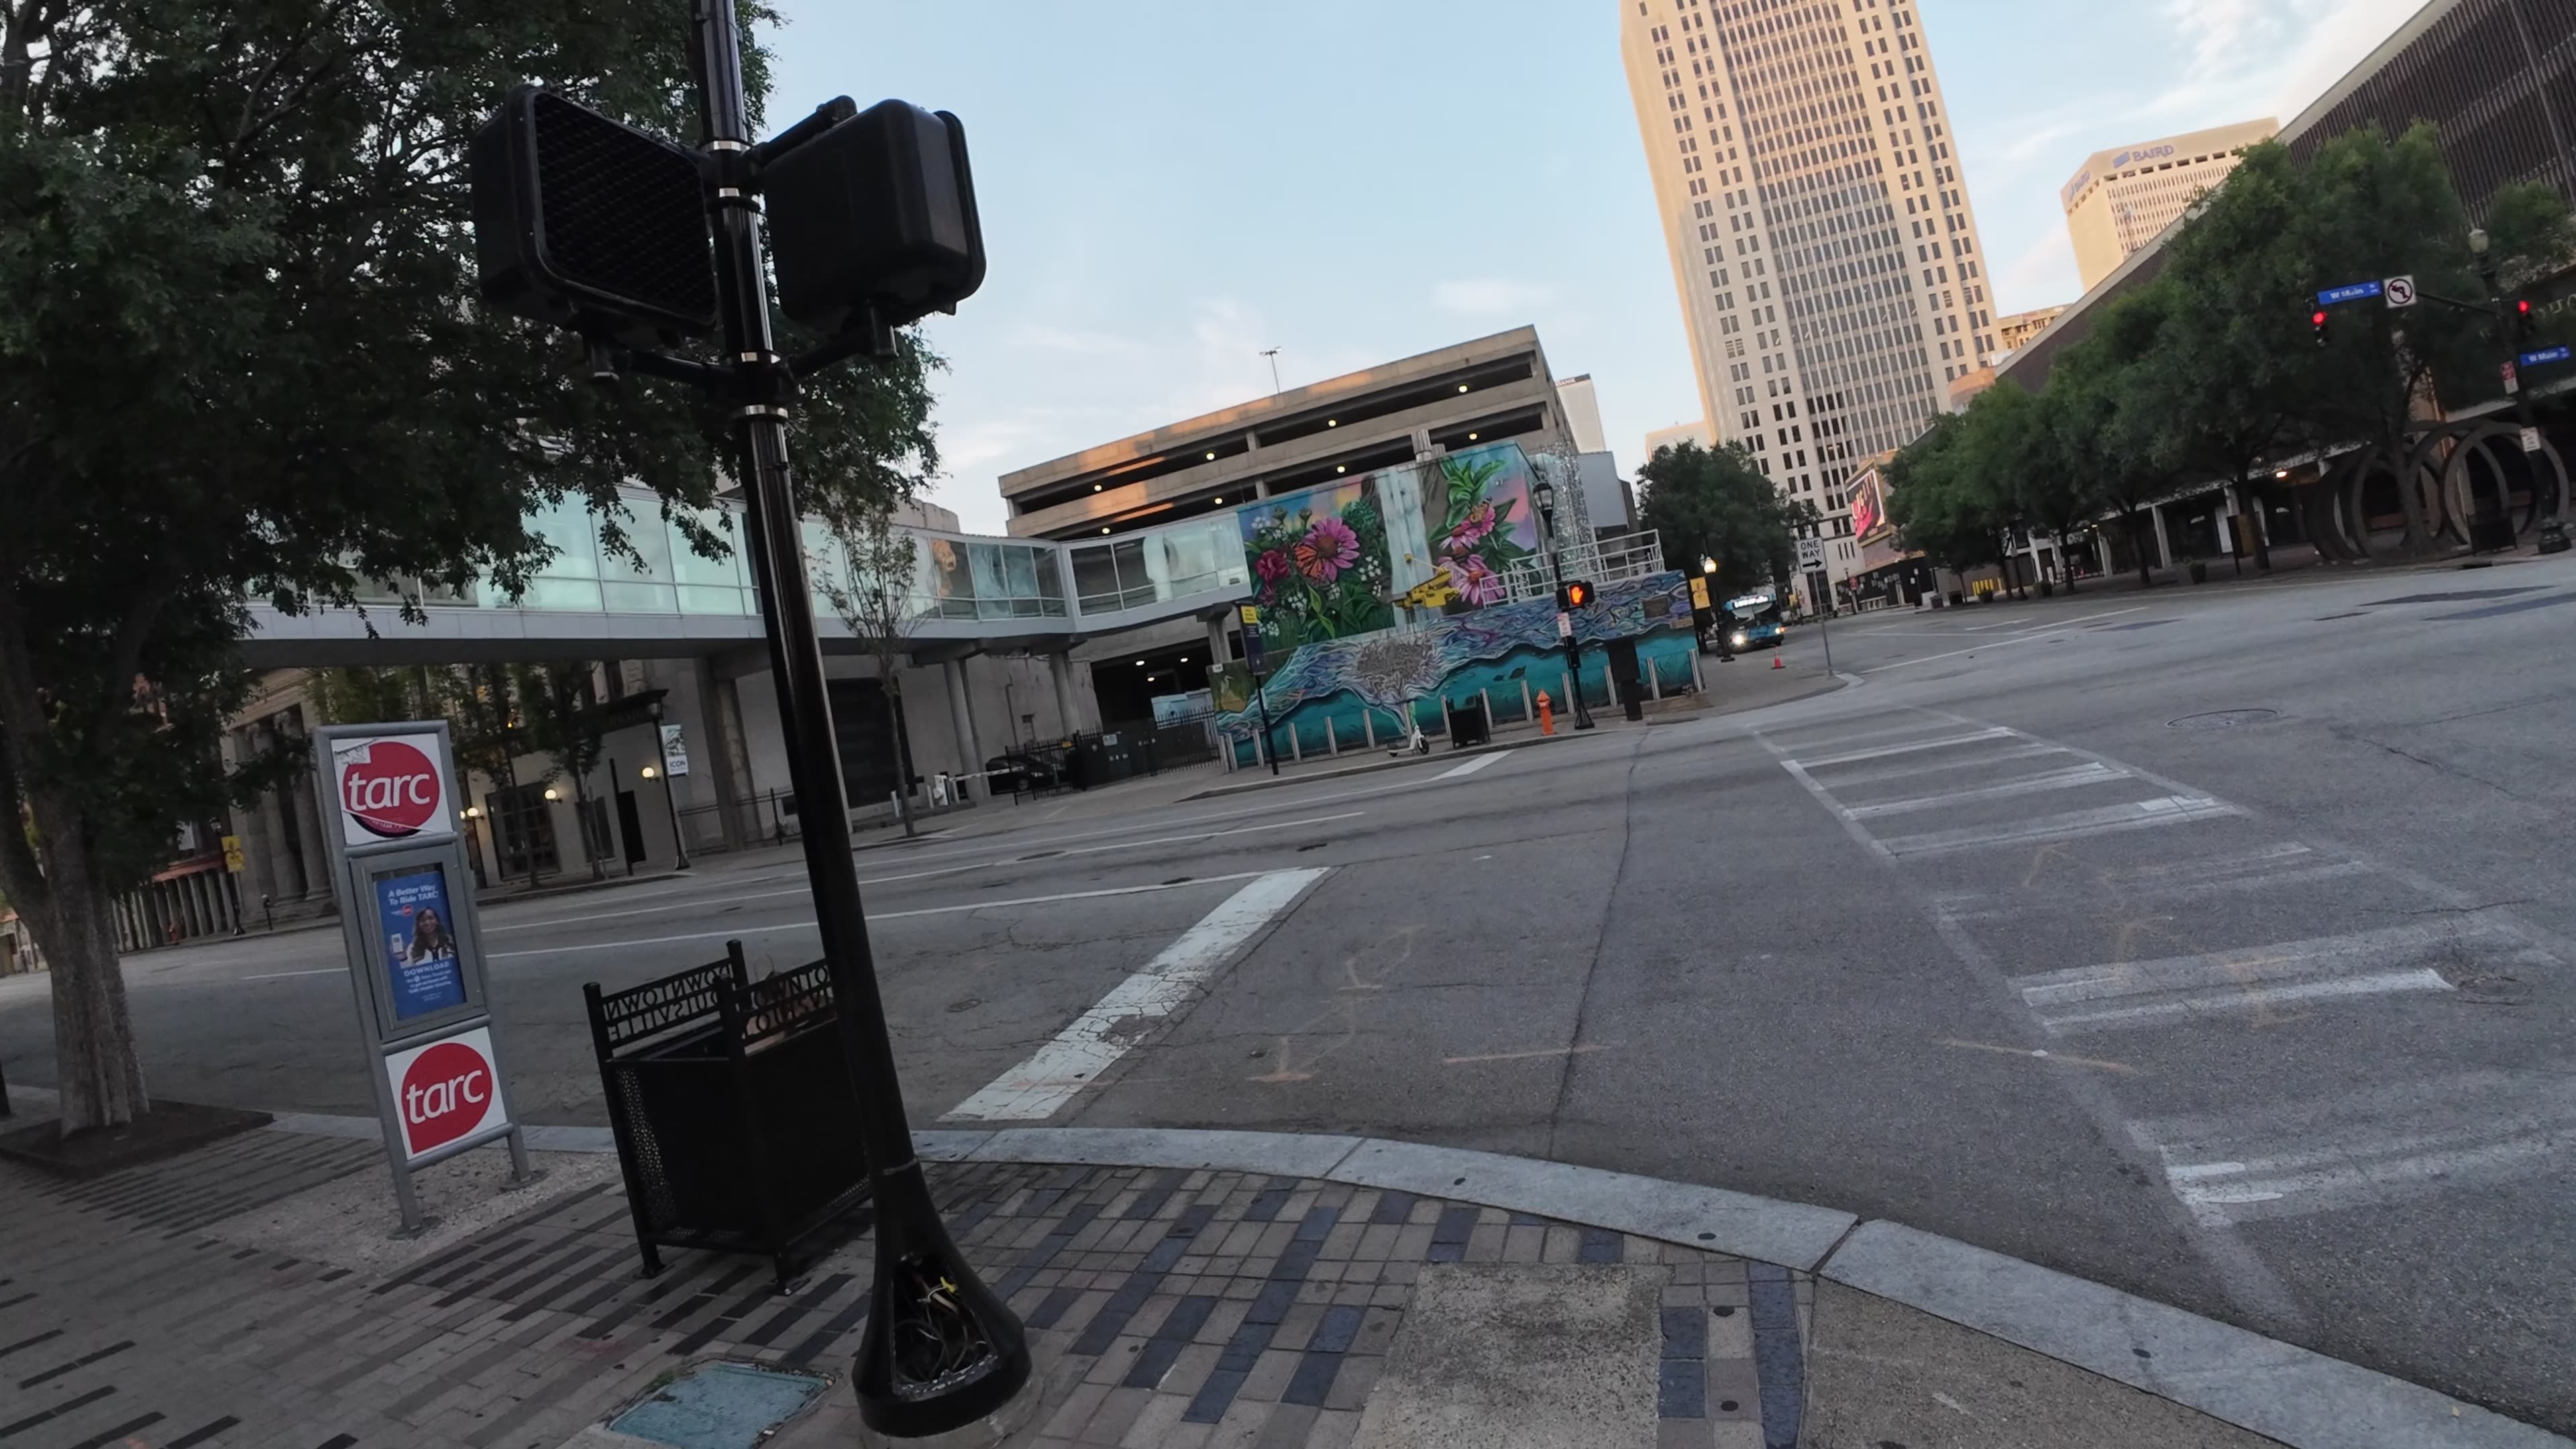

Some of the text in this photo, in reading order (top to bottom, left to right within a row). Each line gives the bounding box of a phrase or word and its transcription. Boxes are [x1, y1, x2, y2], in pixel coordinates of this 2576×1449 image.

[2133, 145, 2174, 162] BAIRD
[1801, 540, 1819, 550] ONE
[1802, 549, 1820, 559] WAY
[348, 772, 430, 811] tarc
[396, 887, 419, 897] Better
[420, 884, 436, 892] Way
[389, 898, 398, 906] To
[400, 895, 417, 904] Ride
[404, 961, 449, 977] DOWNLOAD
[407, 1070, 484, 1124] tarc
